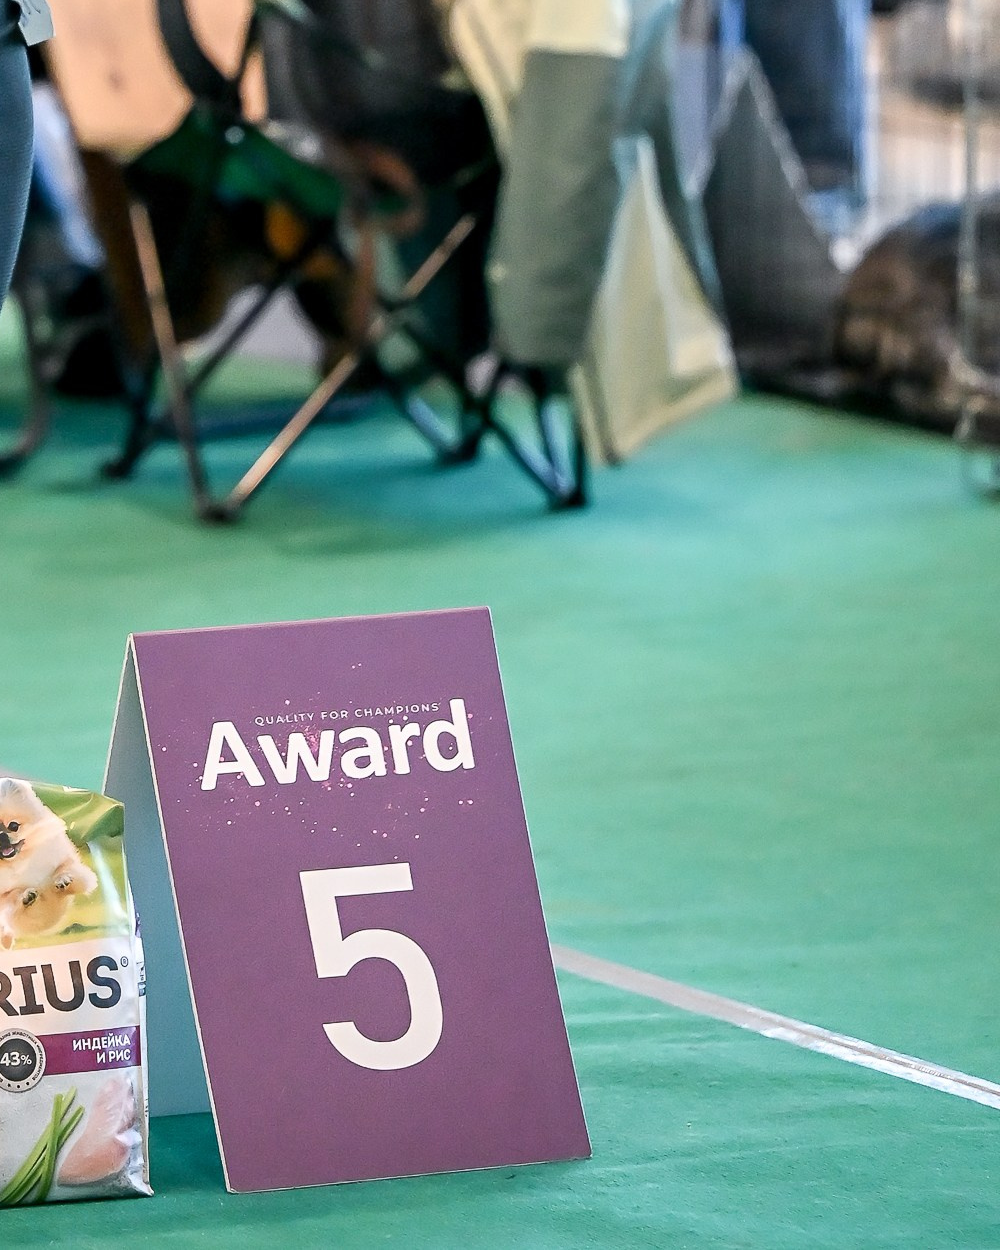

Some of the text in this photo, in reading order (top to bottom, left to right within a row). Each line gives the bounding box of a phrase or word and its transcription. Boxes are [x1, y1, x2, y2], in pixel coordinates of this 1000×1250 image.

[254, 702, 440, 727] QUALITY FOR CHAMPIONS
[200, 697, 476, 791] Award
[299, 862, 445, 1072] 5
[73, 1033, 131, 1052] ИНДЕЙКА
[0, 1051, 32, 1067] 43%
[96, 1049, 132, 1064] И РИС
